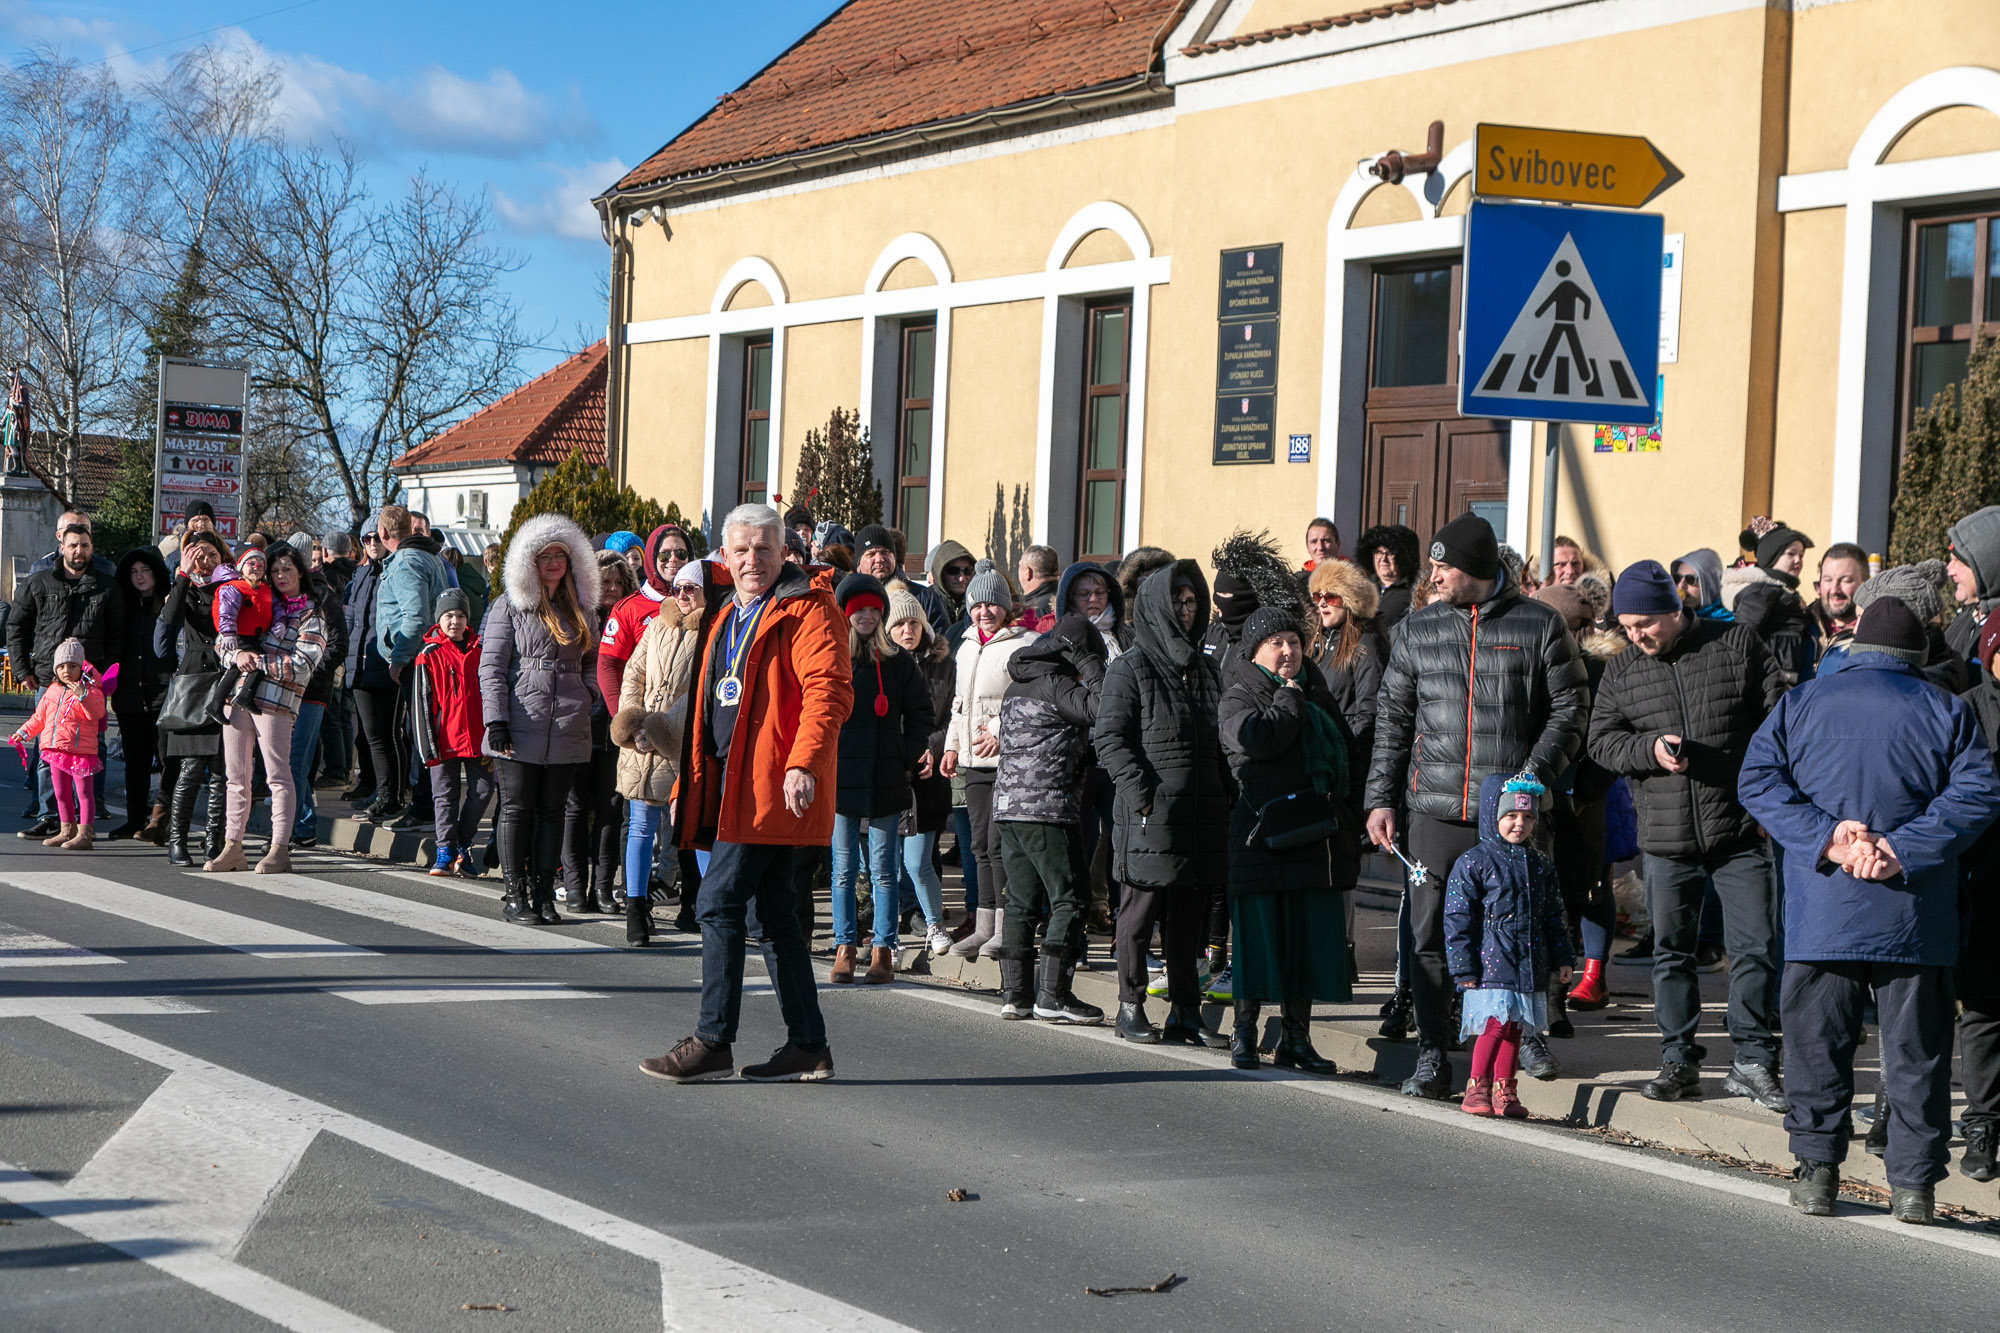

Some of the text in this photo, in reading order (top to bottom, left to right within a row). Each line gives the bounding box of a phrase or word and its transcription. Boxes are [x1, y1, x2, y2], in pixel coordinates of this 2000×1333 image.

[1488, 145, 1616, 190] Svibovec
[185, 411, 230, 429] BIMA
[164, 437, 227, 453] MA-PLAST
[1290, 437, 1309, 454] 188
[186, 458, 234, 473] vatik
[168, 476, 203, 486] Restoran
